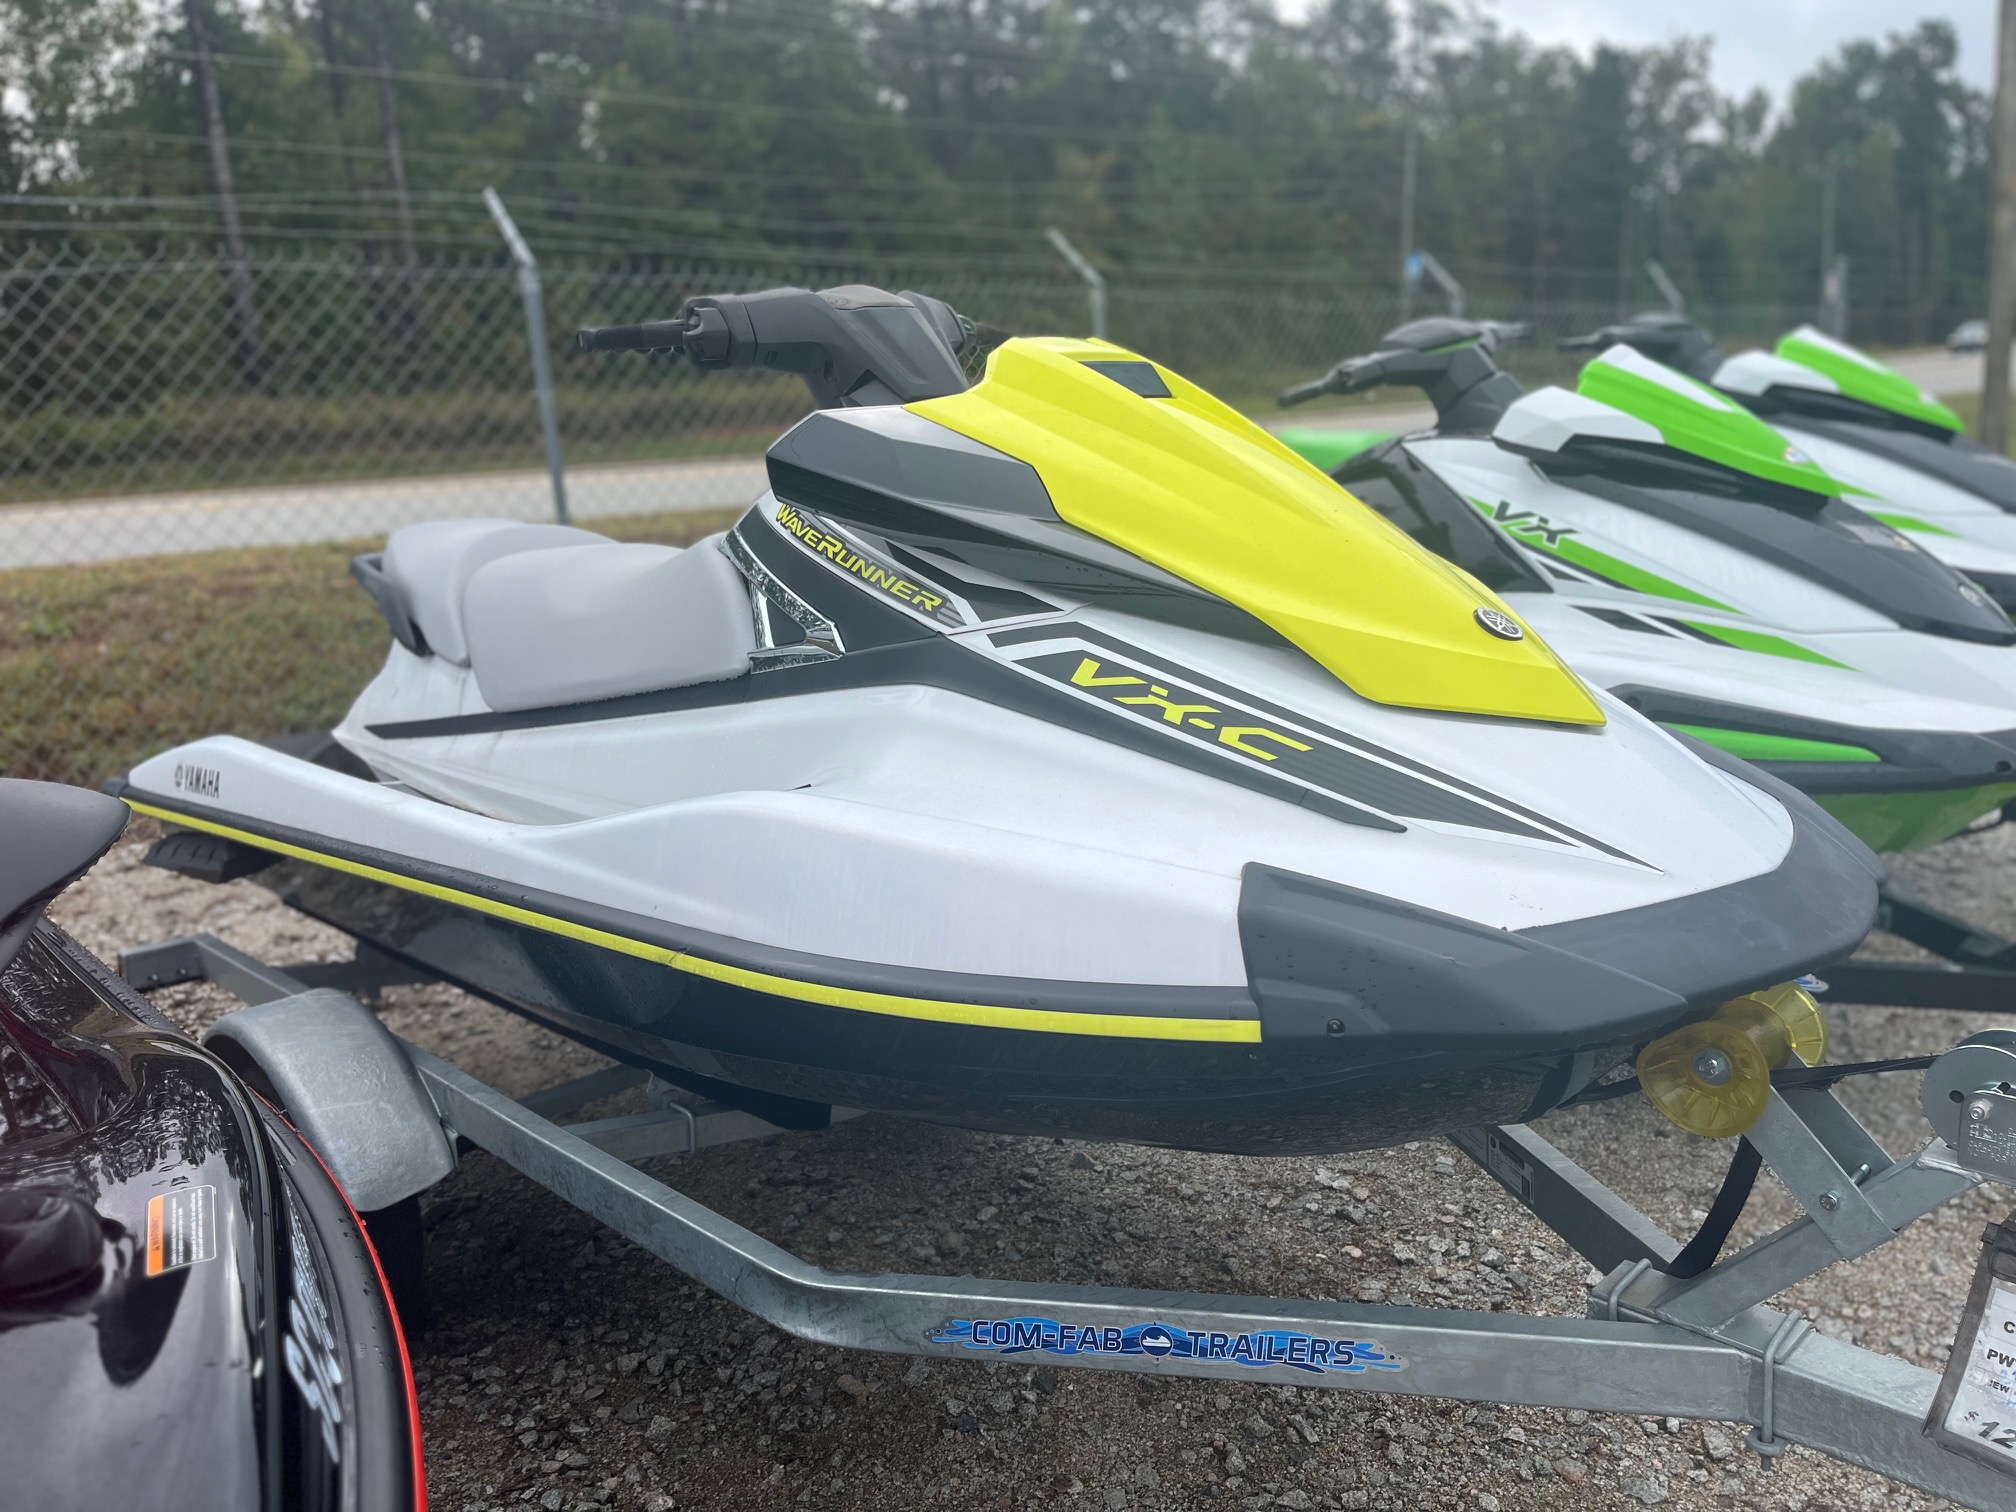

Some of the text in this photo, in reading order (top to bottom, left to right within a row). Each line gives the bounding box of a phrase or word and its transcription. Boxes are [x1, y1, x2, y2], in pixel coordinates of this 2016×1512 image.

[1493, 499, 1580, 547] VX
[1070, 657, 1314, 761] VX-C
[184, 763, 220, 800] YAMAHA
[150, 1214, 160, 1245] WARNING
[971, 1319, 1357, 1366] COM-FAB TRAILERS
[1986, 1348, 2016, 1368] PW
